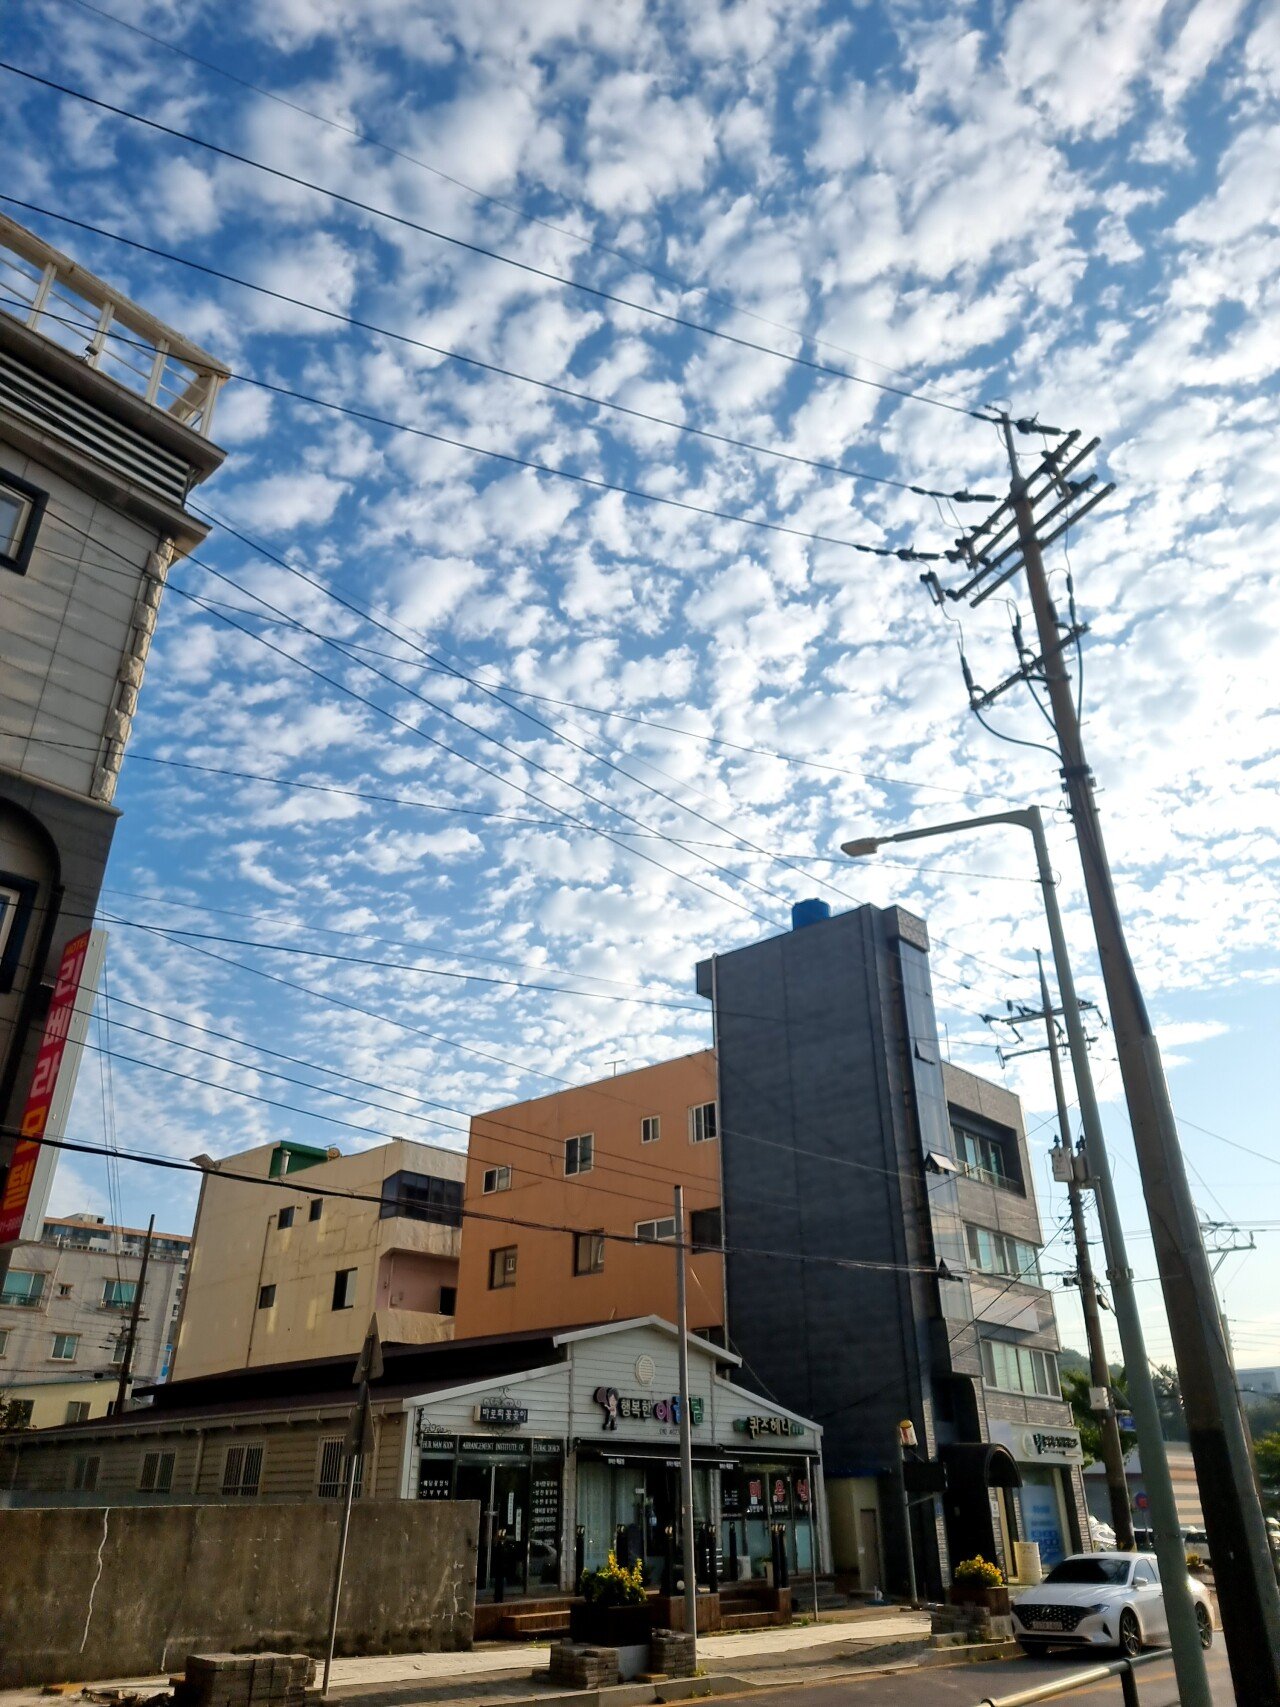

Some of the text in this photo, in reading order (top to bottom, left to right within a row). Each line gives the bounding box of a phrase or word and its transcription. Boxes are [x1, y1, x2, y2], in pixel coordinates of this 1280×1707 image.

[30, 952, 84, 1099] 리베라
[3, 1106, 47, 1210] 모텔
[619, 1397, 651, 1418] 행복한
[462, 1441, 494, 1450] ARRANGEMENT
[496, 1443, 517, 1451] INSTITUTE
[518, 1443, 525, 1451] OF
